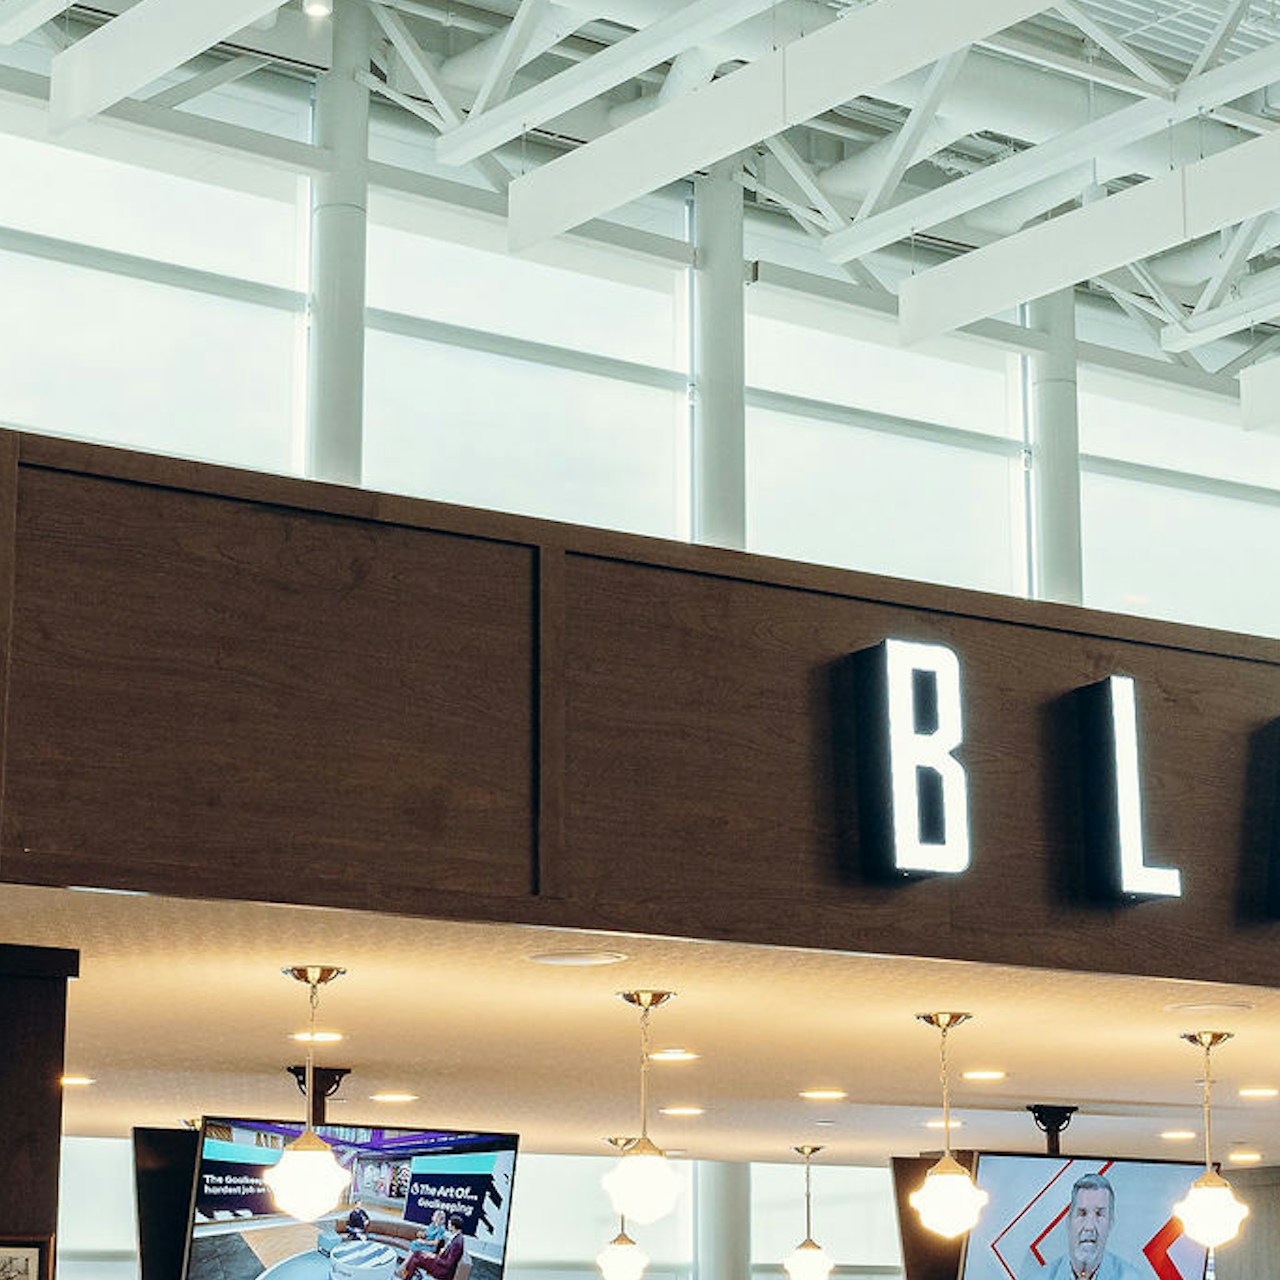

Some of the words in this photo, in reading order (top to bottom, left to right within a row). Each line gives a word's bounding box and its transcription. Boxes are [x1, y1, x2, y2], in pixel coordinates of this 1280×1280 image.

[202, 1174, 223, 1184] The
[420, 1183, 437, 1196] The
[436, 1185, 455, 1198] Art
[418, 1196, 475, 1216] Goalkeeping
